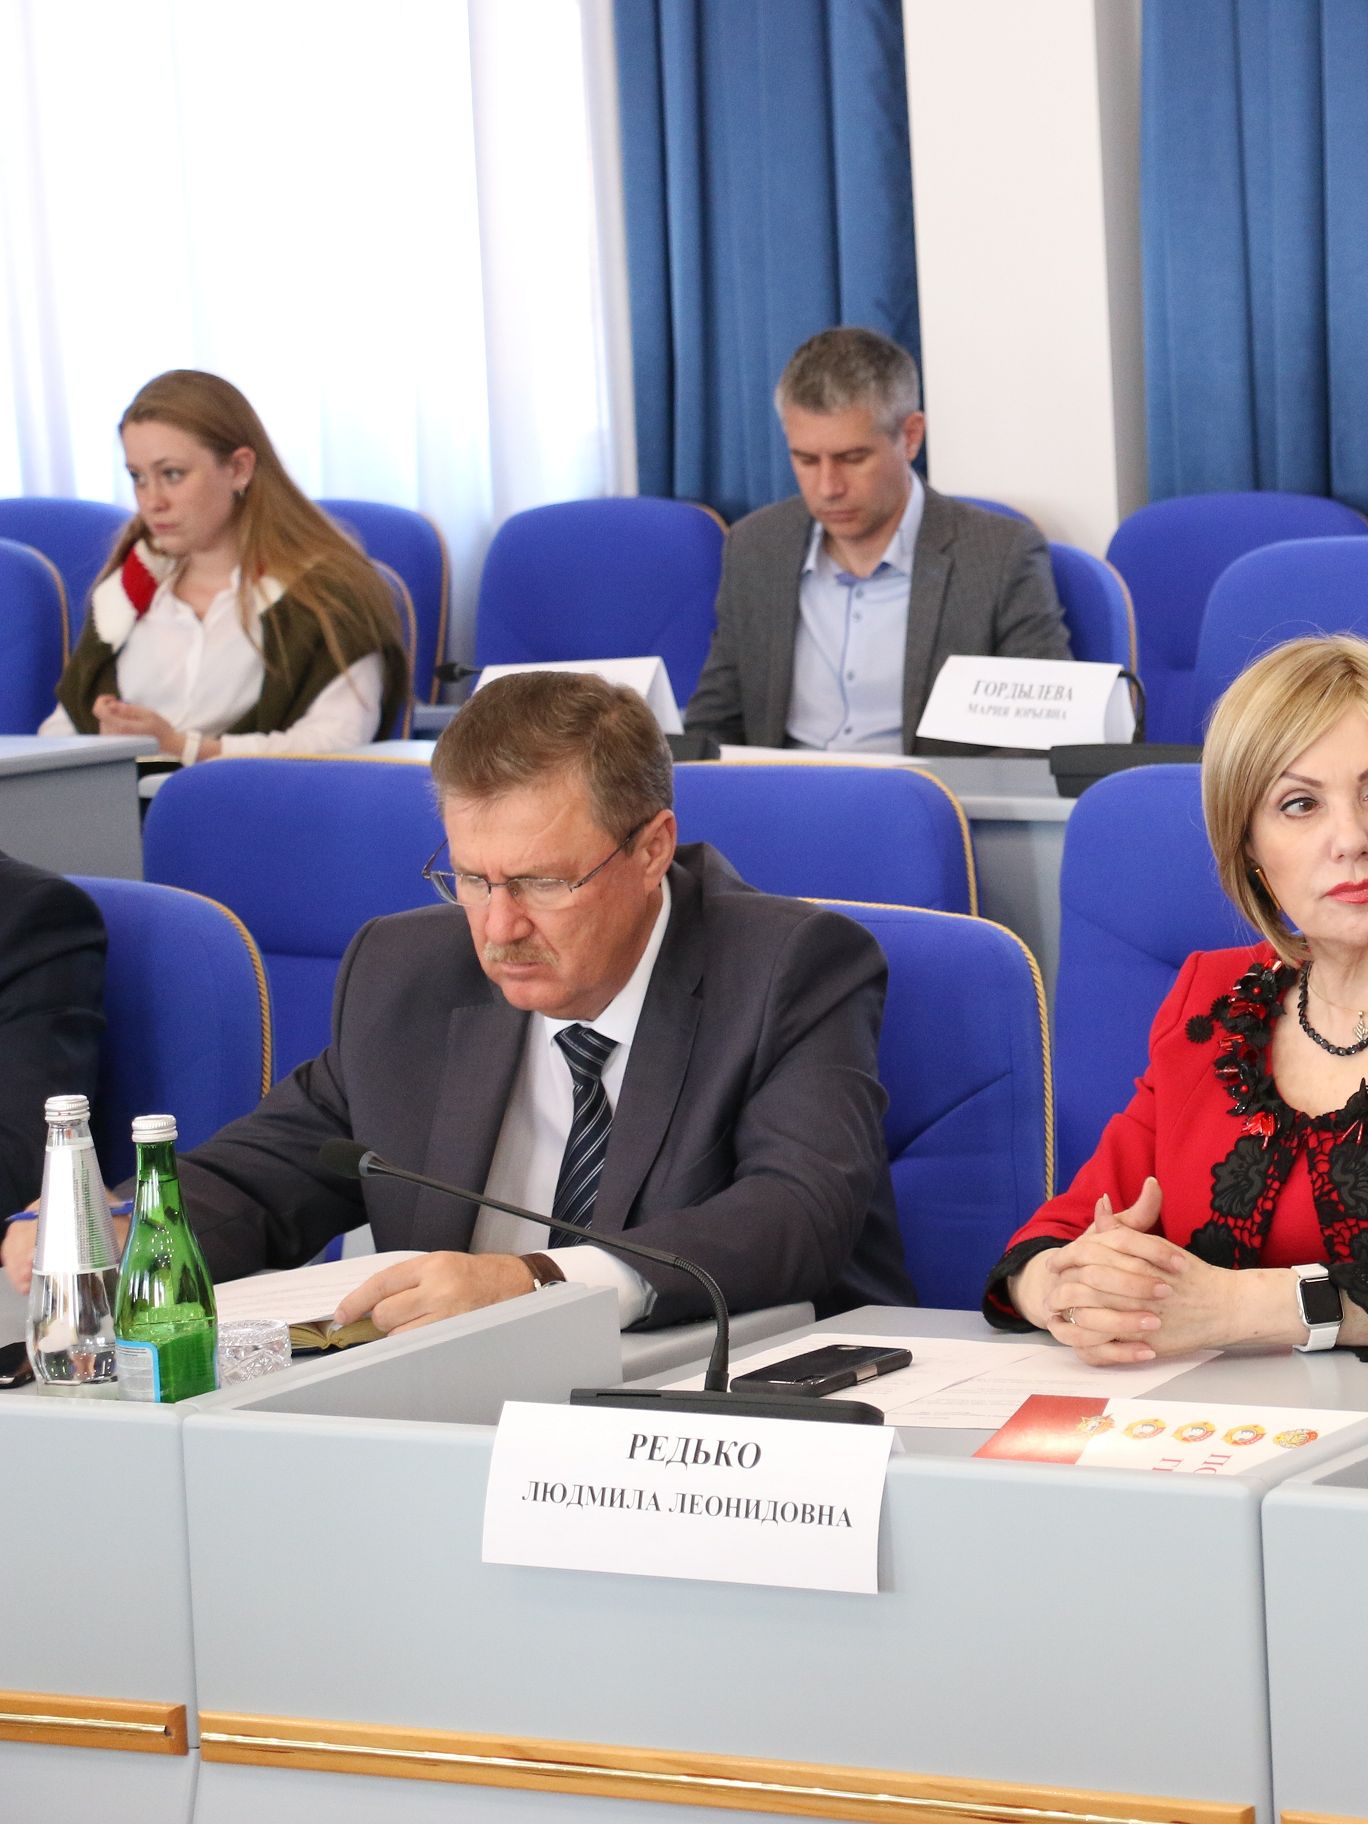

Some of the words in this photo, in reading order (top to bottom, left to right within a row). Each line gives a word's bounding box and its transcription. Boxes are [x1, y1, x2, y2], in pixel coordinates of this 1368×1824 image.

[972, 679, 1073, 702] ГОРДЫЛЕВА
[967, 701, 1010, 717] МАРИЯ
[626, 1432, 762, 1470] РЕДЬКО
[521, 1480, 662, 1513] ЛЮДМИЛА
[667, 1492, 853, 1529] ЛЕОНИДОВНА
